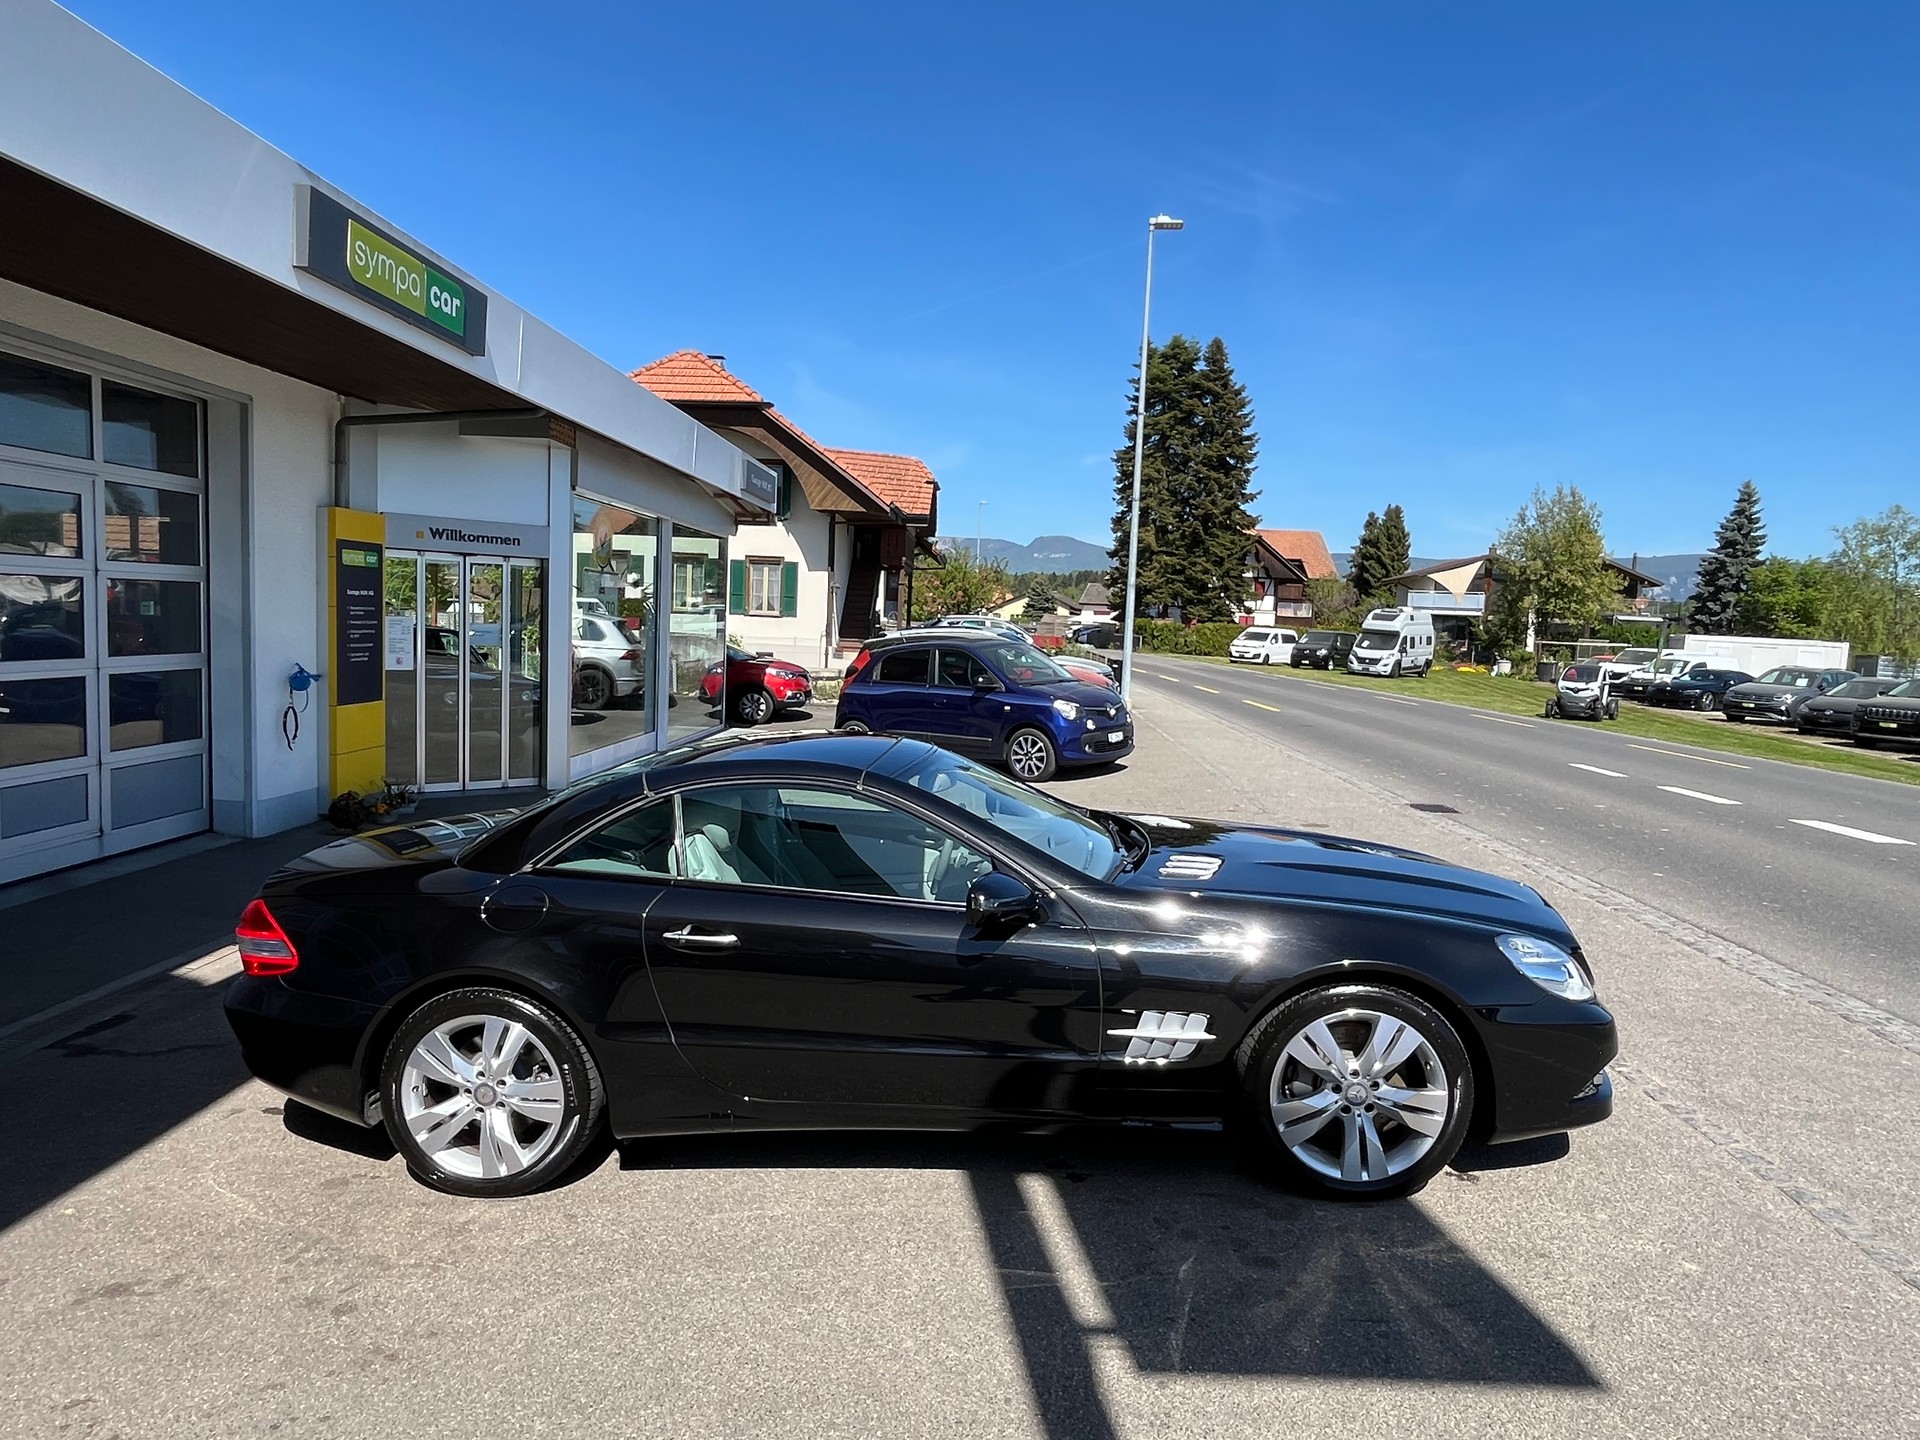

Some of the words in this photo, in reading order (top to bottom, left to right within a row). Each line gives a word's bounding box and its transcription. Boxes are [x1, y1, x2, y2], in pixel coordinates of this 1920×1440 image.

[354, 240, 420, 298] sympa
[430, 285, 461, 318] car
[428, 526, 521, 547] Willkommen
